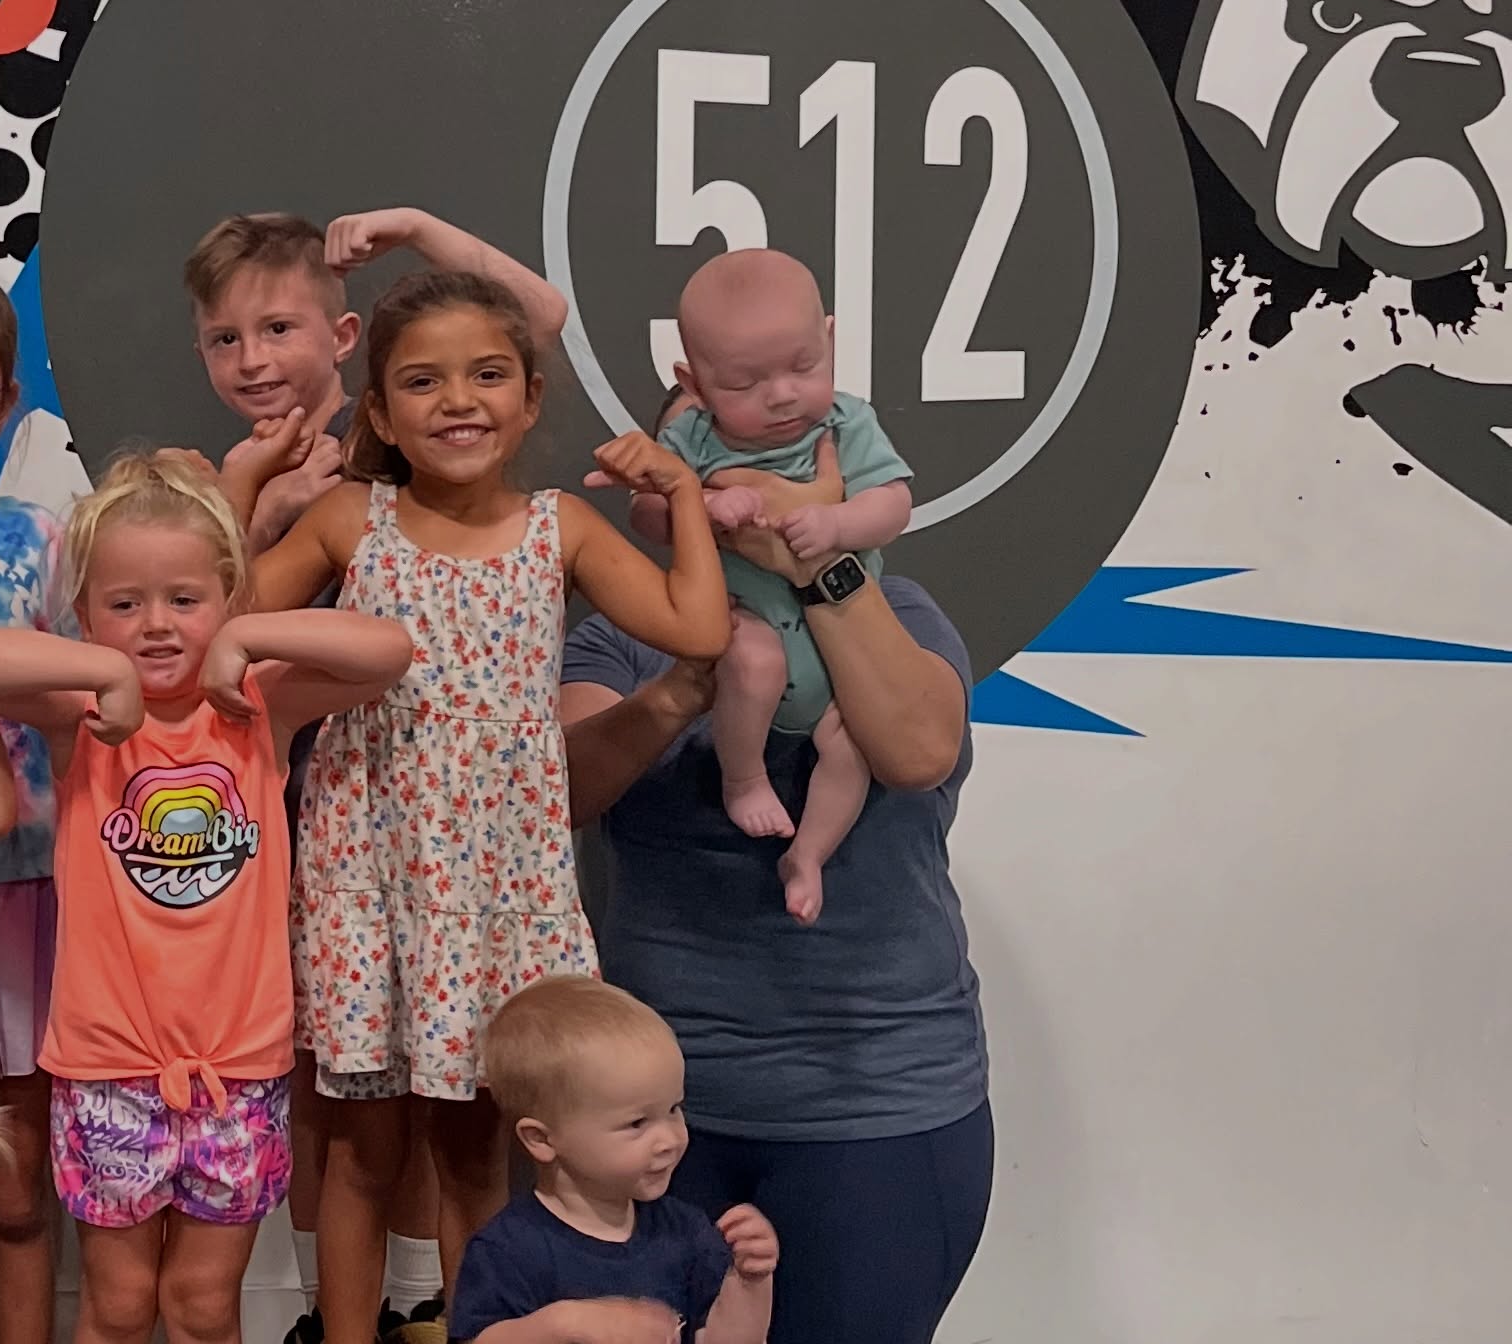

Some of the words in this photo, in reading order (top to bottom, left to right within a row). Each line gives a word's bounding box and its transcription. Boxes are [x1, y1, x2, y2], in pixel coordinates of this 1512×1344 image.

[649, 48, 1029, 403] 512
[102, 808, 207, 856] Dream
[205, 808, 260, 856] Big
